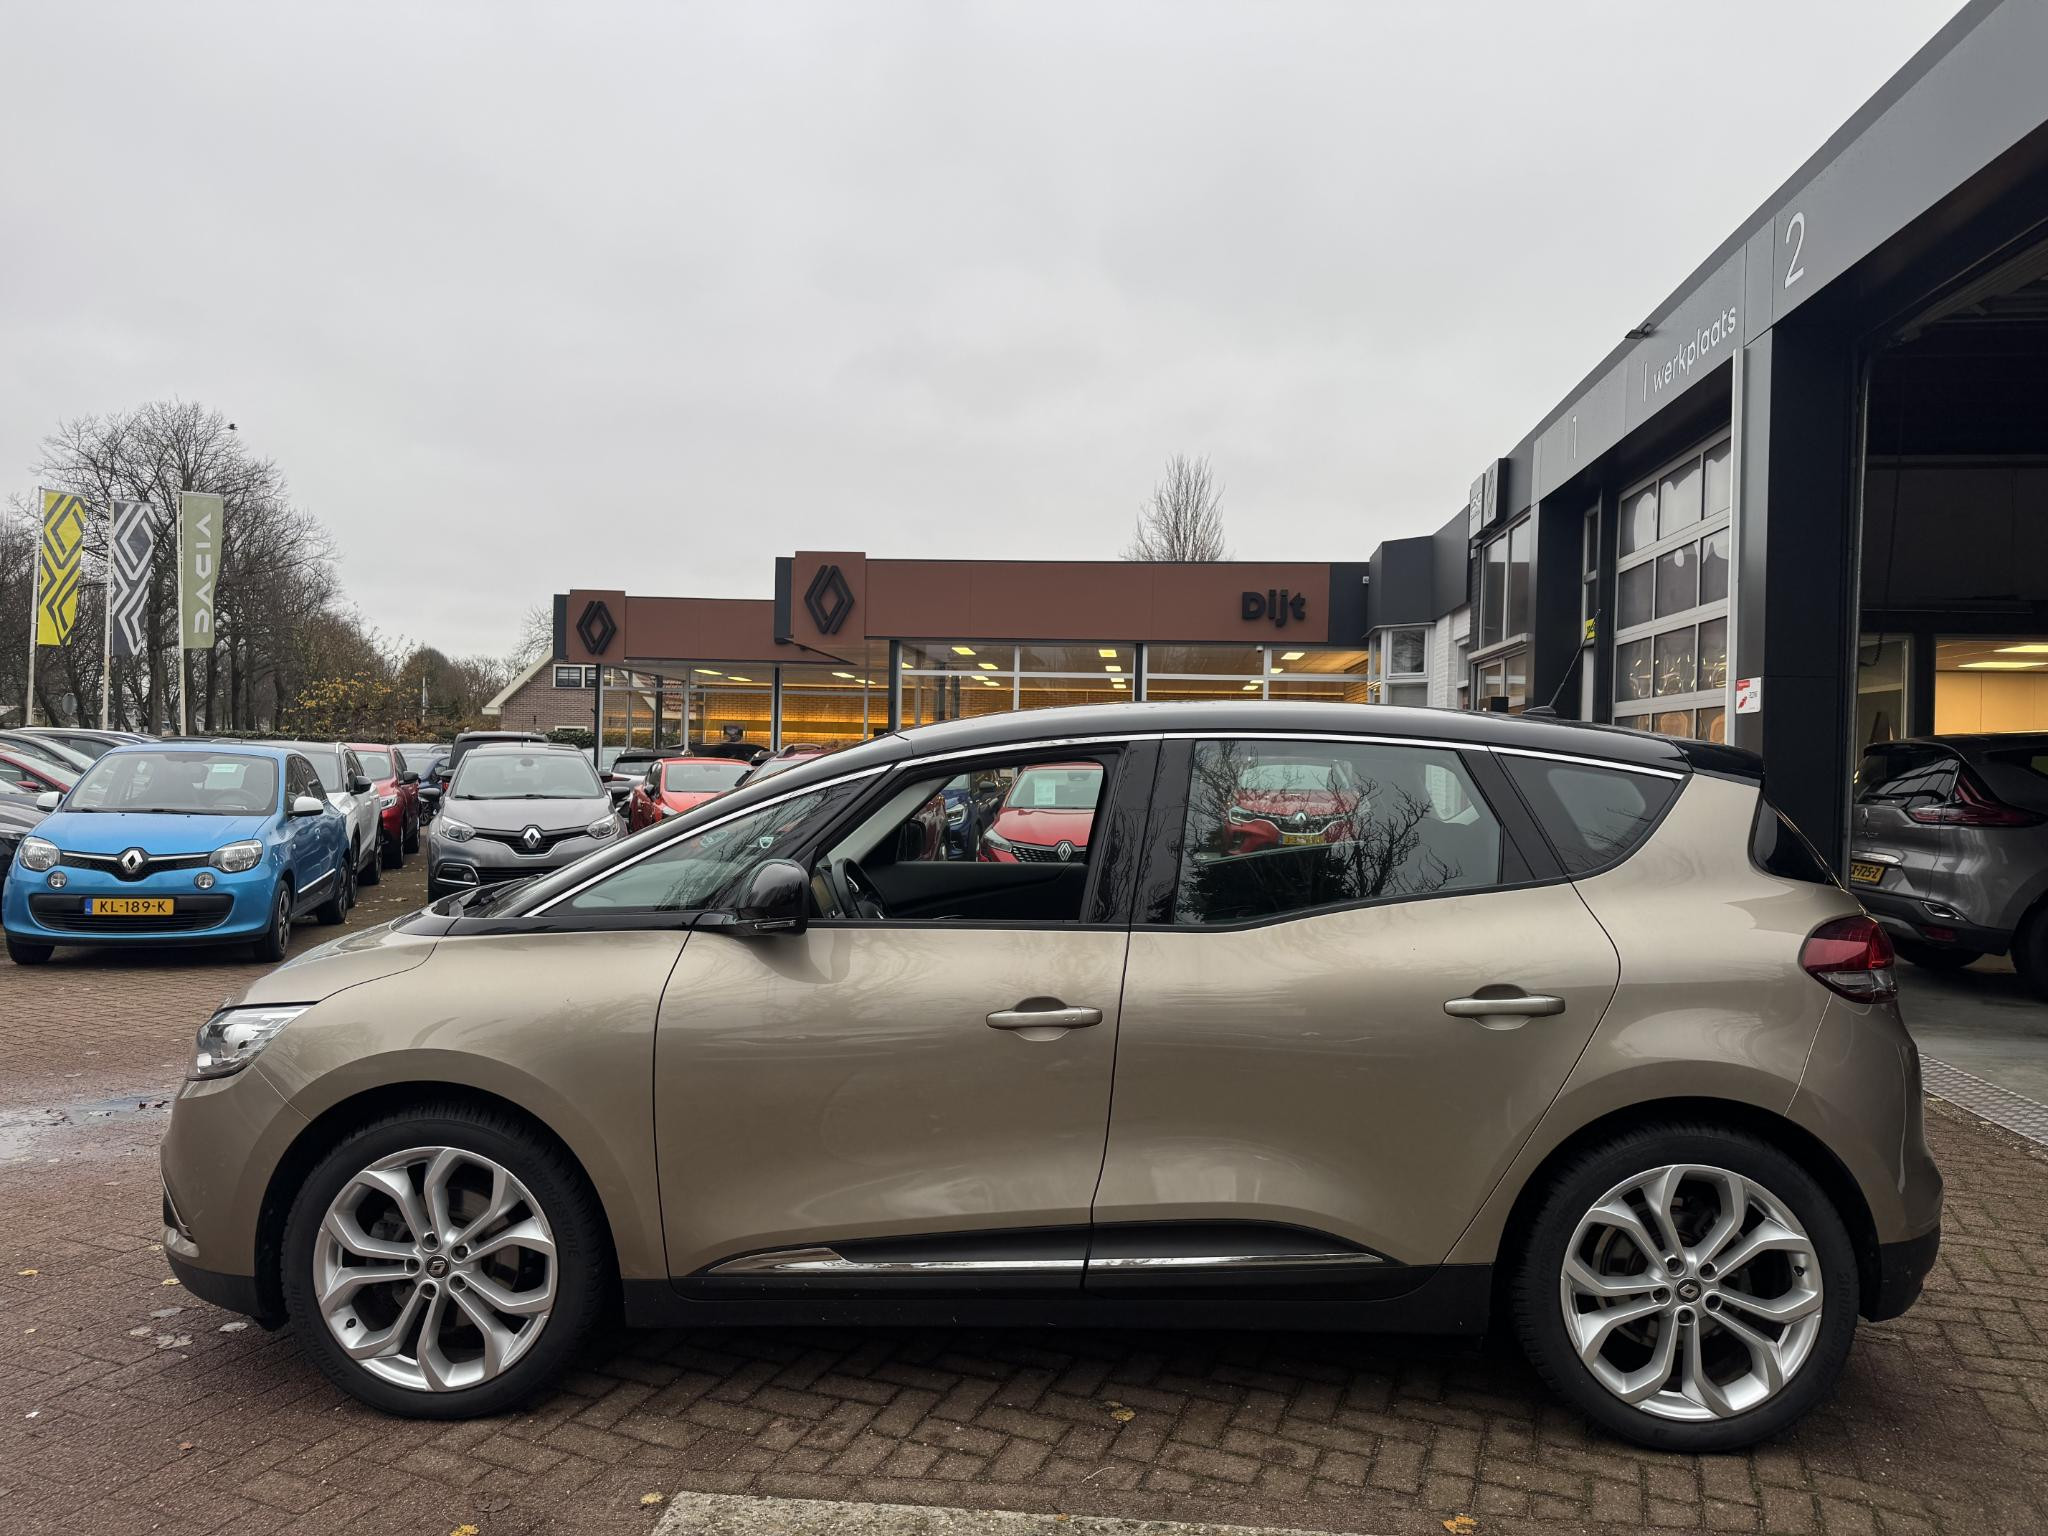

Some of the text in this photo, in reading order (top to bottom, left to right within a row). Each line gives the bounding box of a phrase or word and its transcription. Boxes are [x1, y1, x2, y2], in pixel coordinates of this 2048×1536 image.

[1784, 211, 1805, 289] 2
[1653, 306, 1736, 393] werkplaats
[193, 512, 212, 634] DACIA
[1241, 588, 1307, 629] Dijt
[99, 900, 167, 913] KL-189-K
